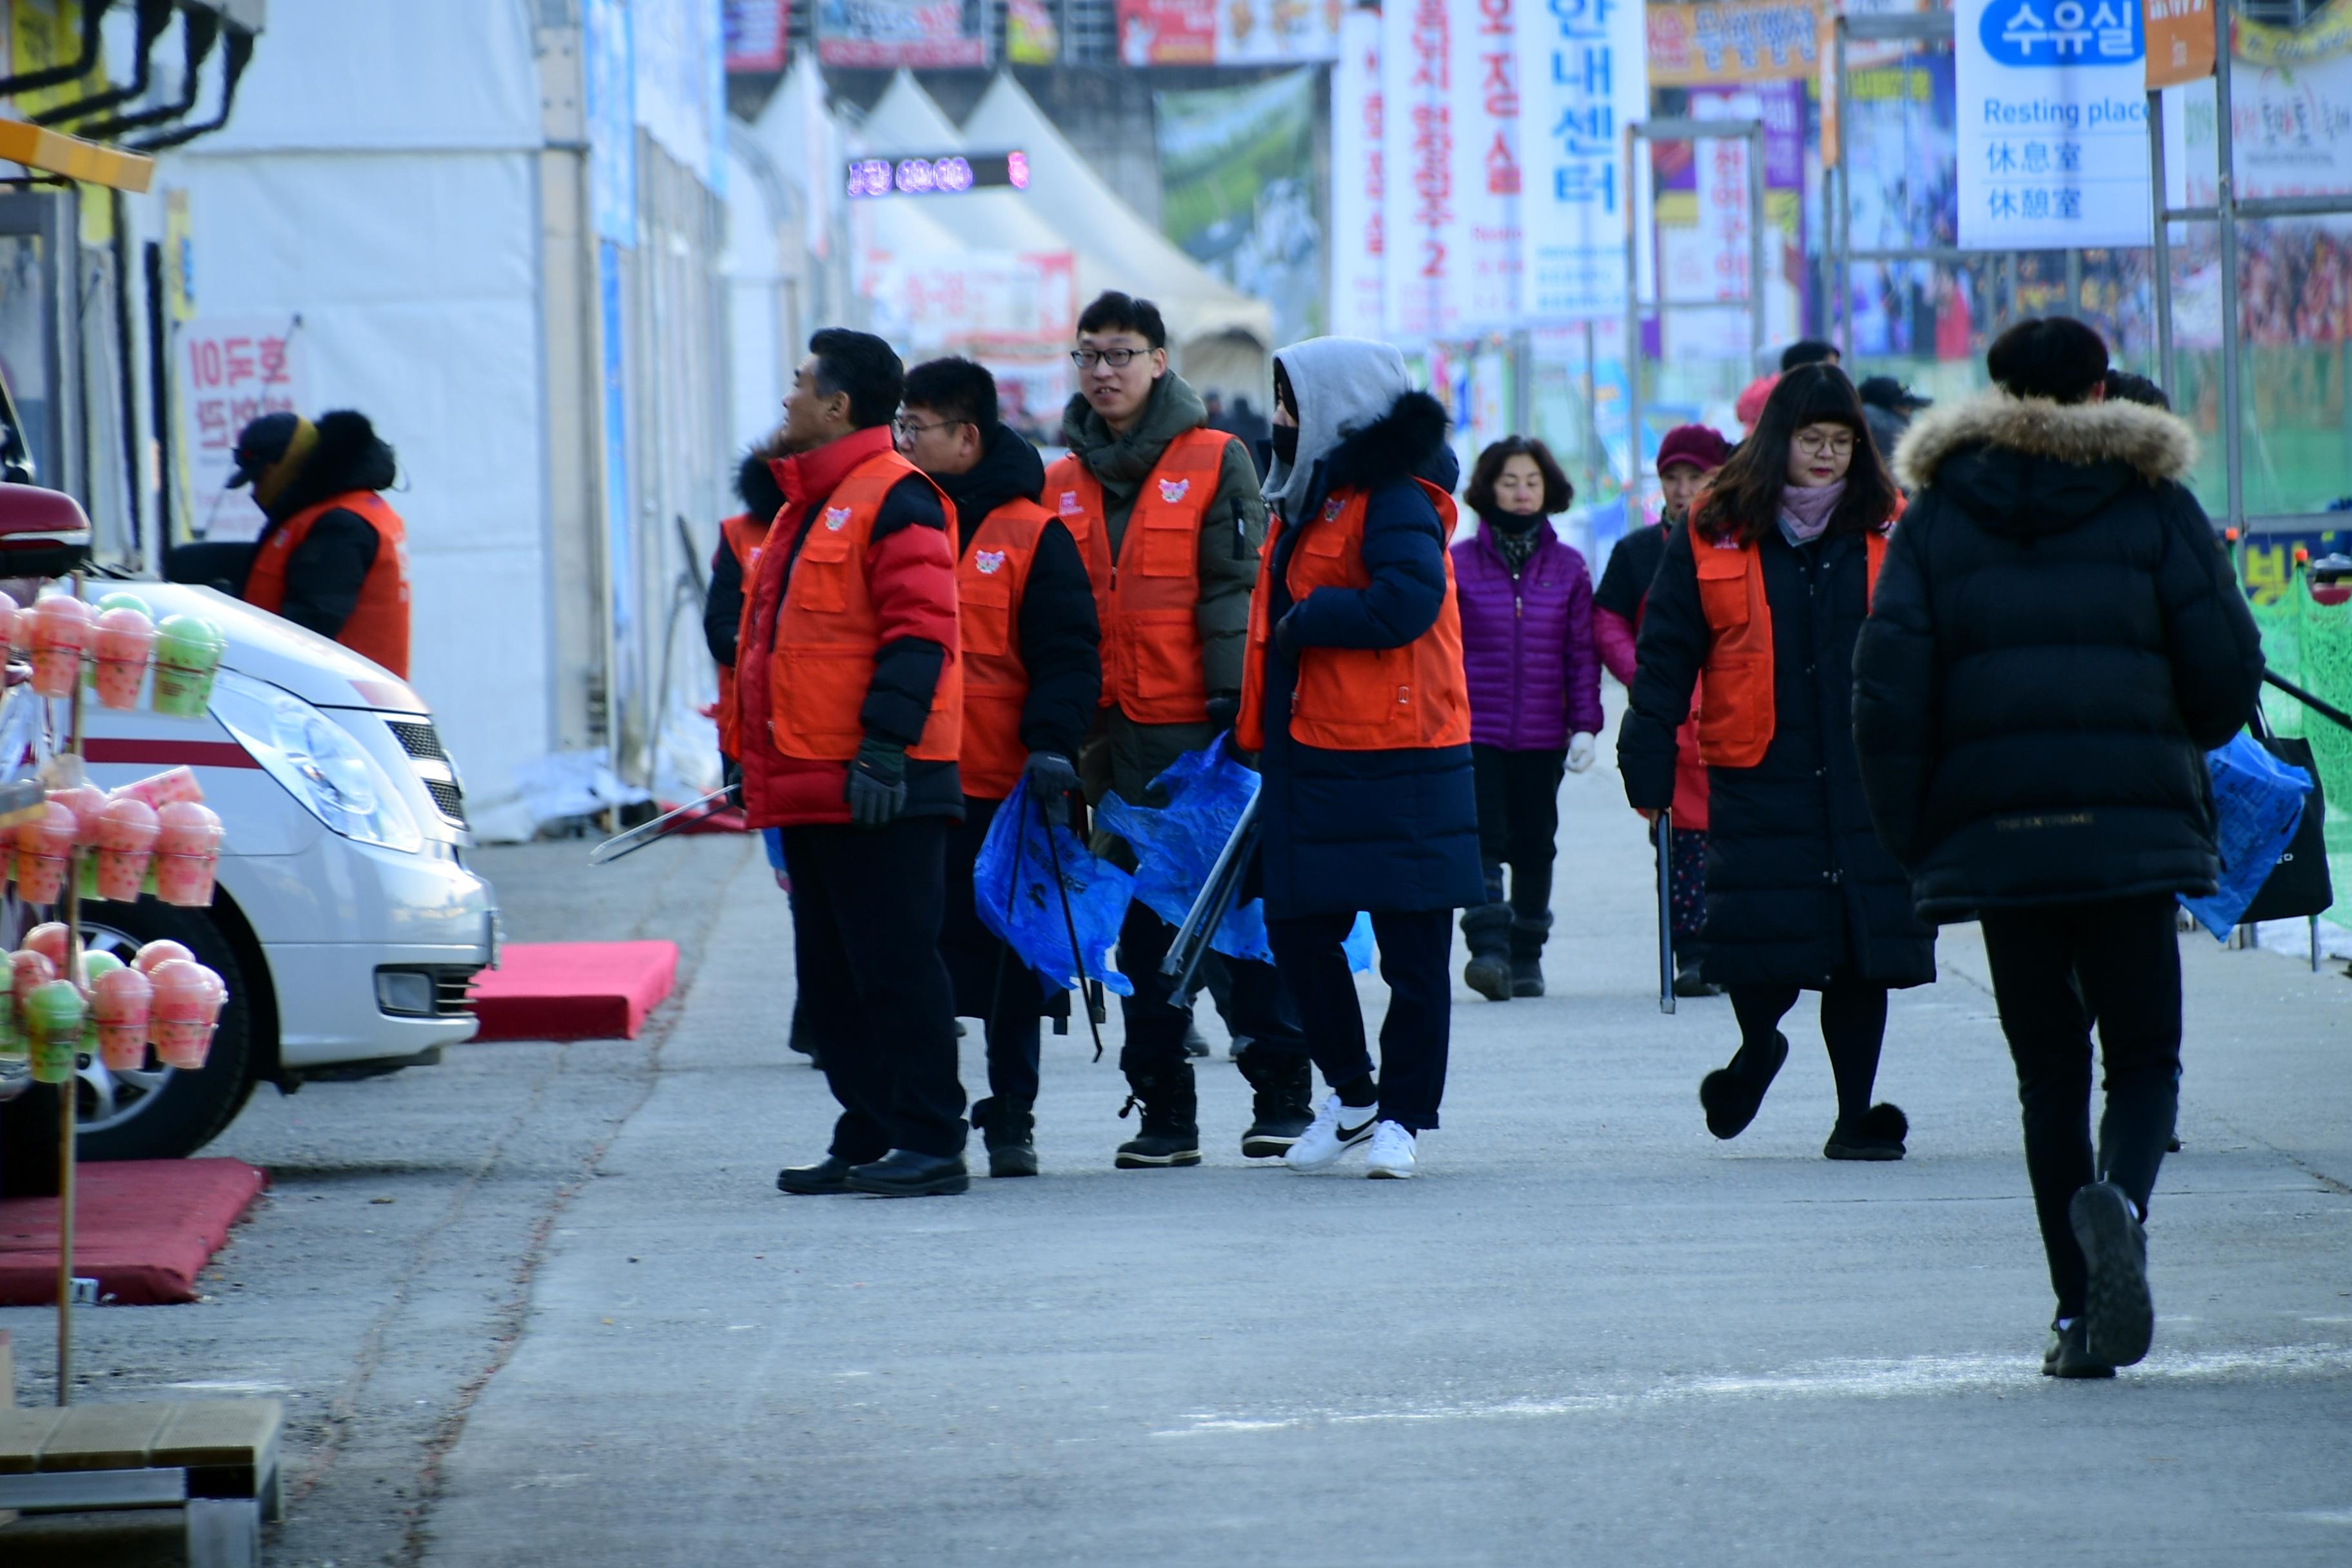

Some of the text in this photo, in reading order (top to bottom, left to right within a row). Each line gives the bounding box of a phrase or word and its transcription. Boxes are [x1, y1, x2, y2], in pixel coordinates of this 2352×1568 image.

[2002, 1, 2134, 56] 수유실
[1547, 0, 1617, 215] 안내센터
[1984, 98, 2079, 130] Resting
[1986, 140, 2082, 174] 休息室
